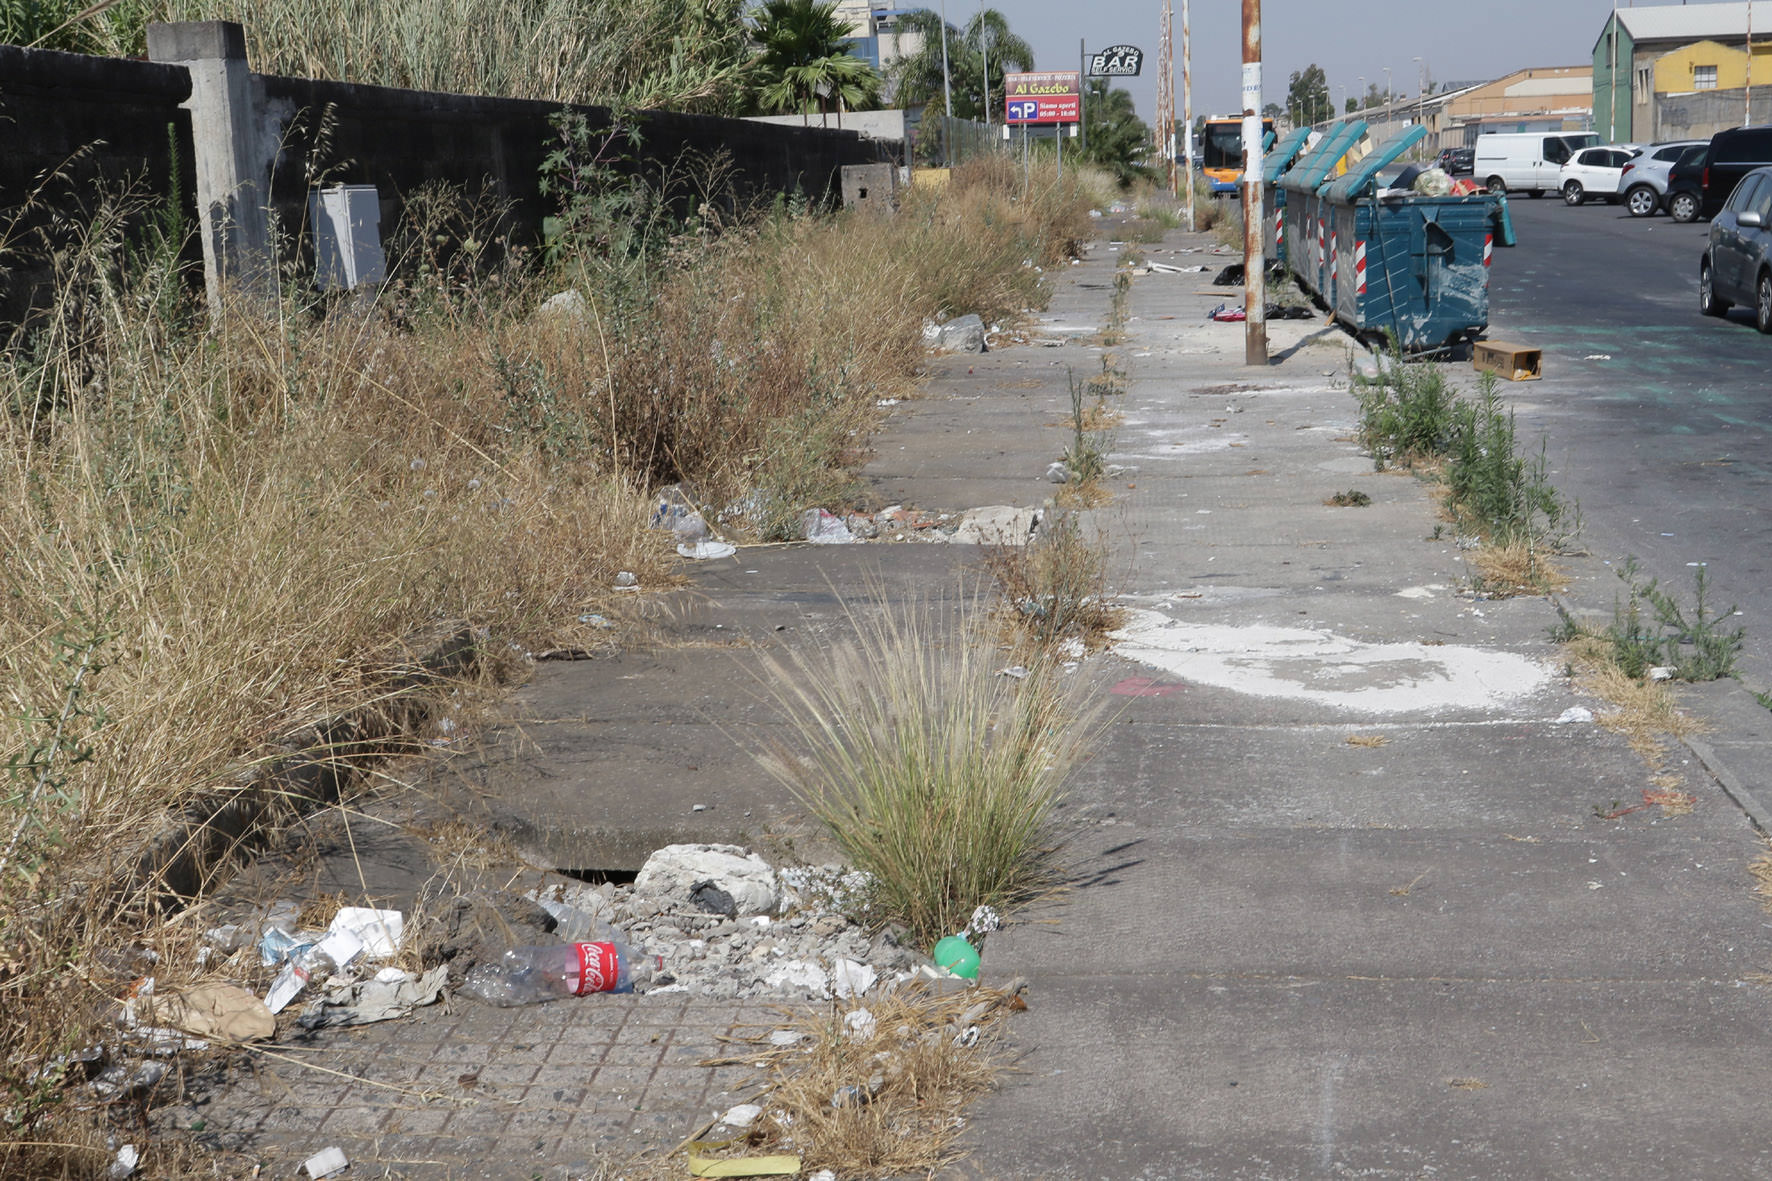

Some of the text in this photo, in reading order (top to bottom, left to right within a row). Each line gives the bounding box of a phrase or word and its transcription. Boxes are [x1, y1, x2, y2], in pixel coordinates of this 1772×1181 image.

[1103, 46, 1139, 57] AL GAZEBO
[1093, 56, 1138, 67] BAR
[1015, 82, 1070, 94] Al Gazebo
[1023, 102, 1035, 118] P
